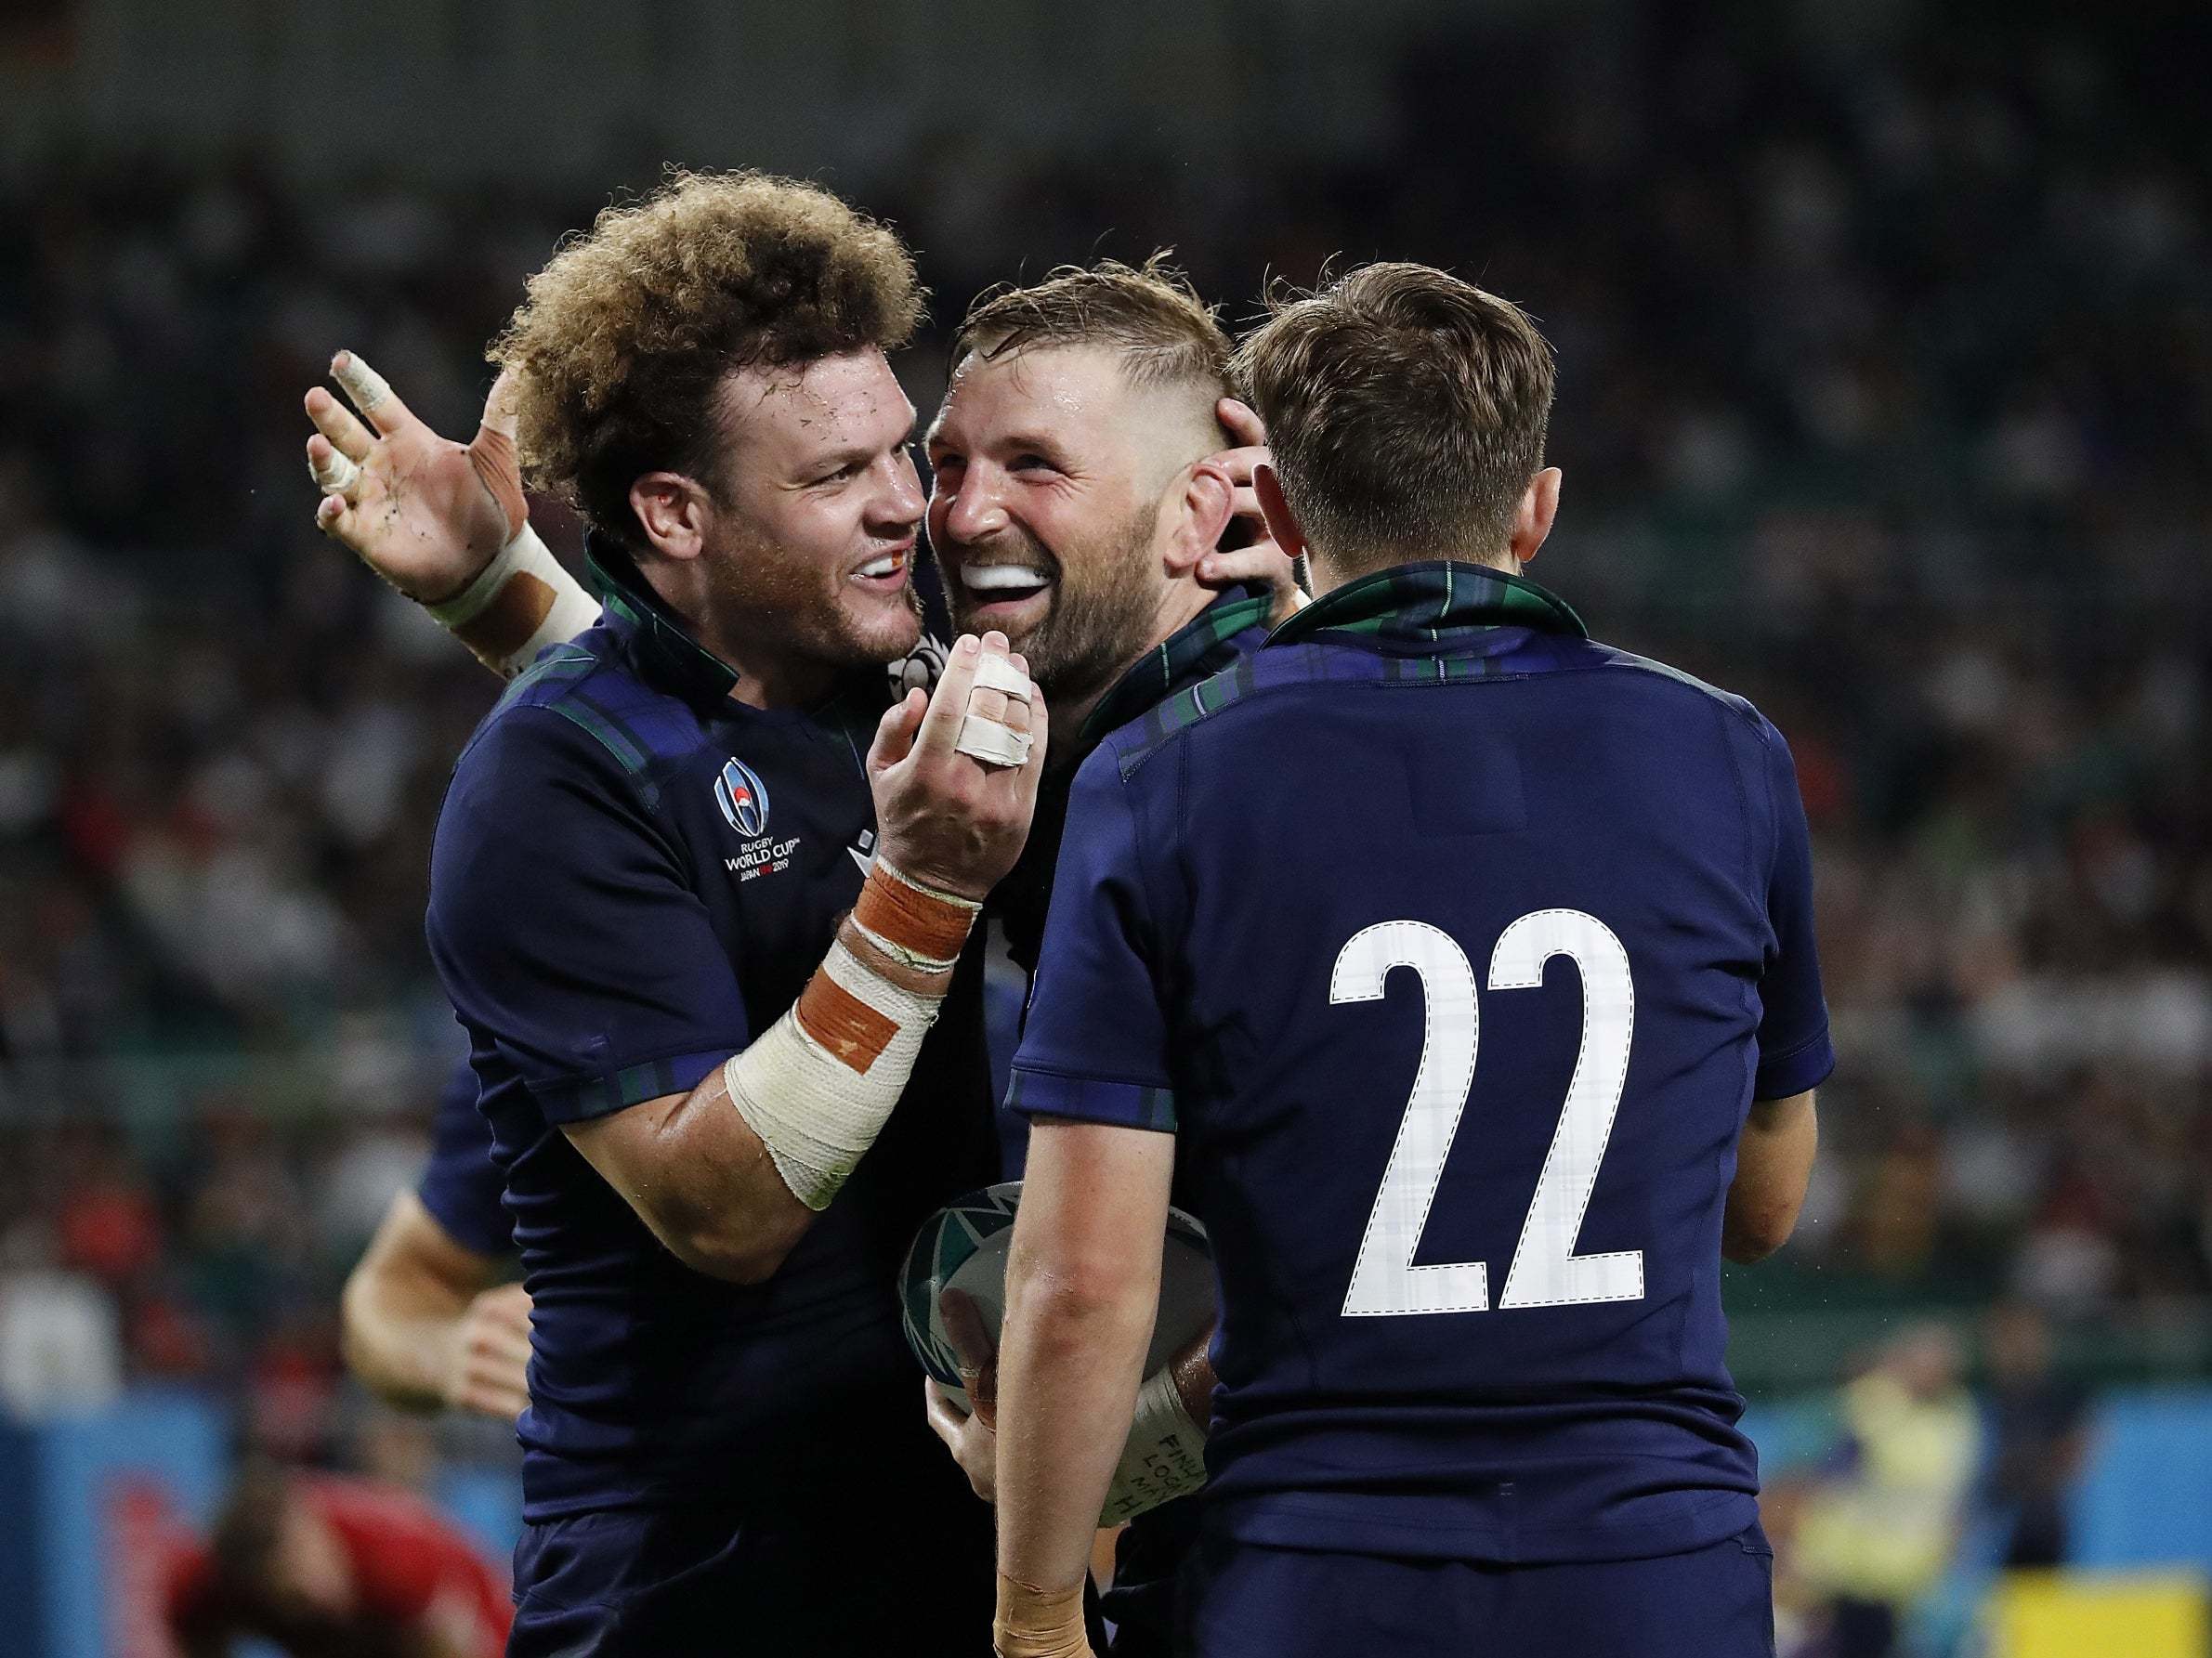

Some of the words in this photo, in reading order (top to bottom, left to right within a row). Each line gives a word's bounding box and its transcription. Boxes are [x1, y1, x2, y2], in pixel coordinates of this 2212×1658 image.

[740, 836, 774, 854] RUGBY
[725, 849, 771, 870] WORLD
[740, 868, 760, 881] JAPAN
[772, 858, 789, 872] 2019
[1329, 907, 1644, 1316] 22
